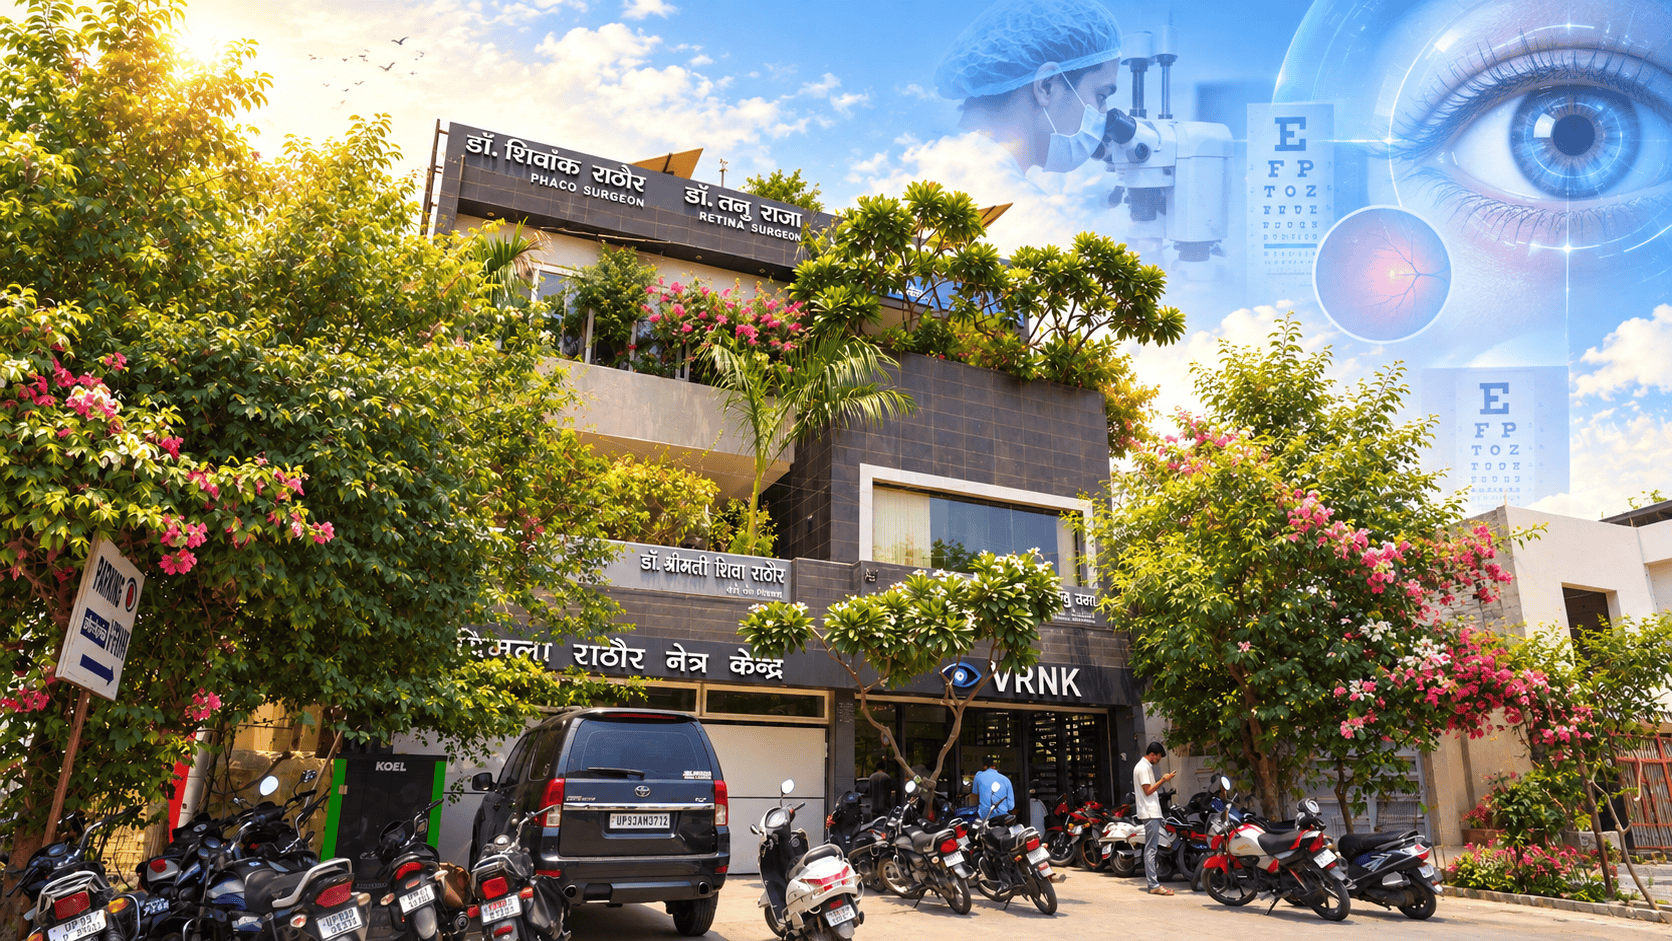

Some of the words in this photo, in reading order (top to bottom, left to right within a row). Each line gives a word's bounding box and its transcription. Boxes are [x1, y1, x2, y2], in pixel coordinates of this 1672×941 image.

[465, 132, 498, 157] डॉ.
[591, 163, 647, 193] राठौर
[530, 172, 577, 193] PHACO
[583, 185, 645, 208] SURGEON
[684, 184, 713, 207] डॉ.
[717, 194, 753, 222] तनु
[760, 204, 803, 228] राजा
[698, 211, 745, 230] RETINA
[751, 223, 802, 242] SURGEON
[92, 555, 126, 609] PARKING
[640, 549, 661, 571] डॉ.
[663, 551, 711, 577] श्रीमती
[714, 556, 746, 580] शिवा
[751, 560, 786, 584] राठौर
[572, 636, 647, 670] राठौर
[665, 642, 710, 674] नेत्र
[729, 647, 785, 680] केन्द्र
[990, 659, 1083, 698] VRNK
[375, 761, 407, 772] KOEL
